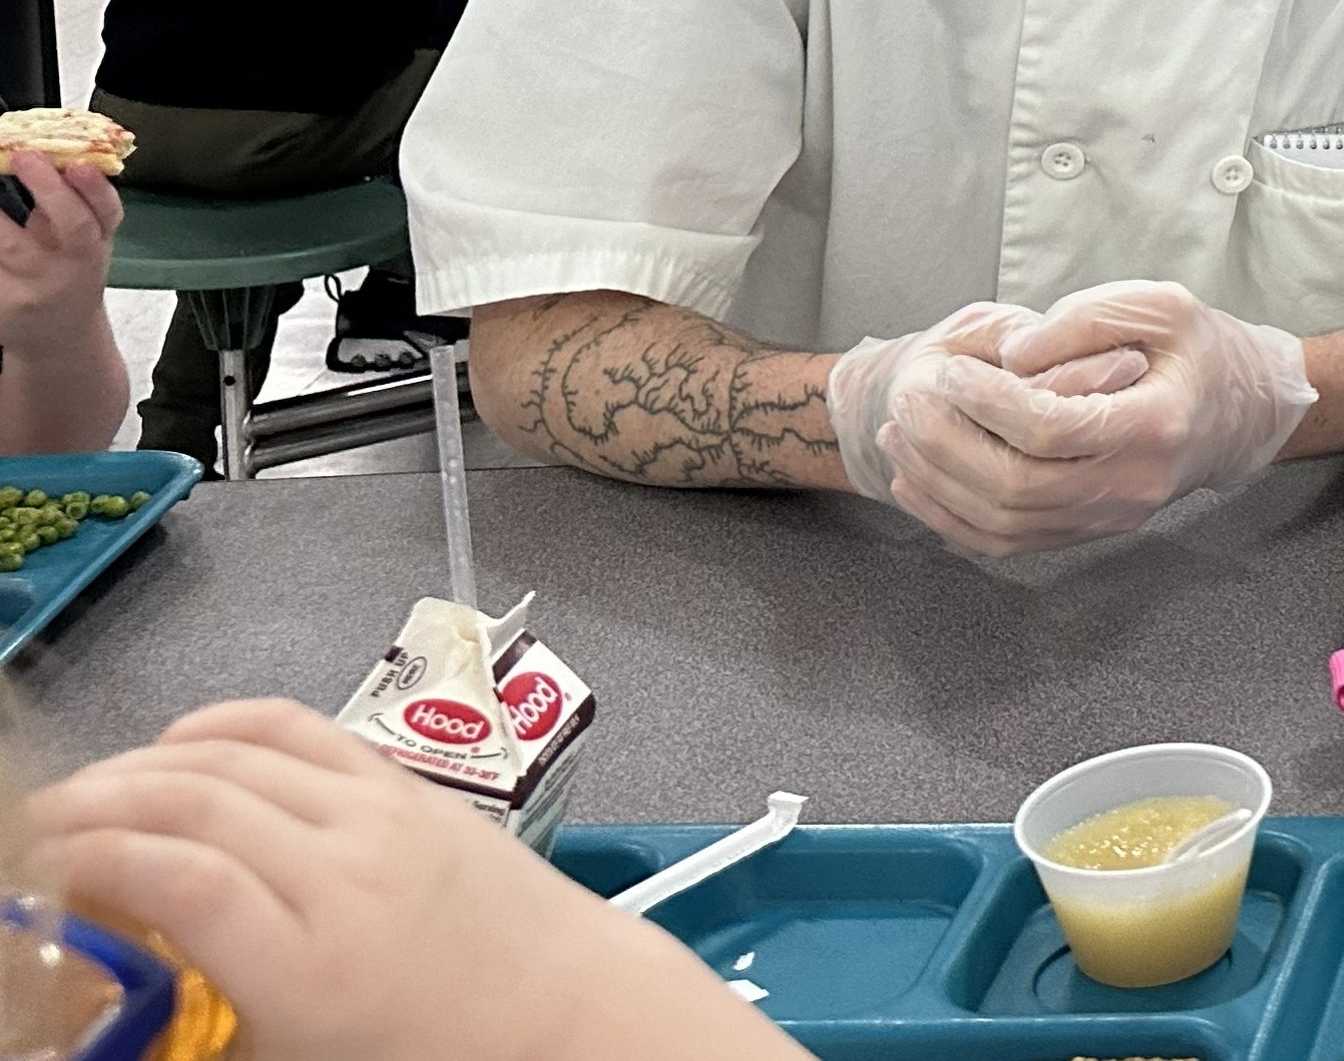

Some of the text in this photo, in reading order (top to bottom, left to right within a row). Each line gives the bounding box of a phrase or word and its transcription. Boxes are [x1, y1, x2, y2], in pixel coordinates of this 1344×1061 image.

[370, 651, 410, 698] PUSH UP
[410, 703, 485, 739] Hood
[506, 676, 559, 735] Hood
[396, 733, 468, 761] TO OPEN
